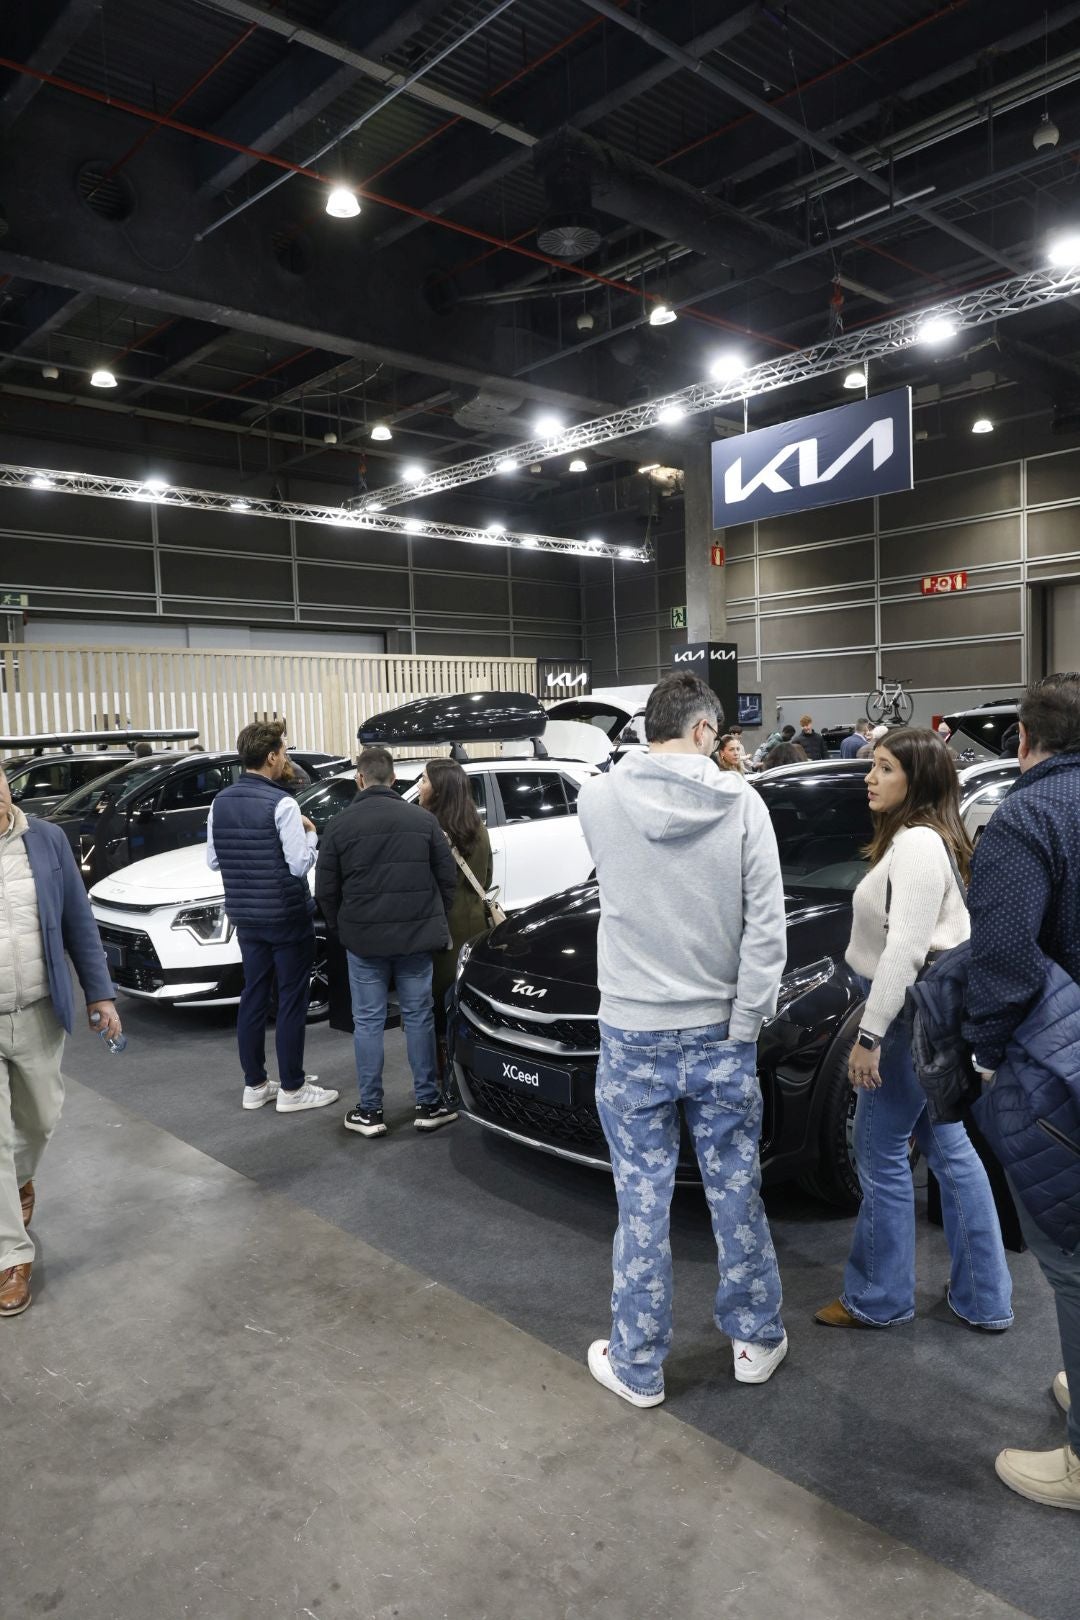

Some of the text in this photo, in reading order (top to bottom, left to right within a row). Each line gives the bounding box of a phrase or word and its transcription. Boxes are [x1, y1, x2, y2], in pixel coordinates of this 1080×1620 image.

[724, 418, 894, 504] KIA
[674, 649, 705, 663] KIA
[710, 650, 736, 660] KIA
[547, 672, 588, 687] KIA
[511, 979, 548, 998] KIA
[502, 1062, 540, 1087] XCeed
